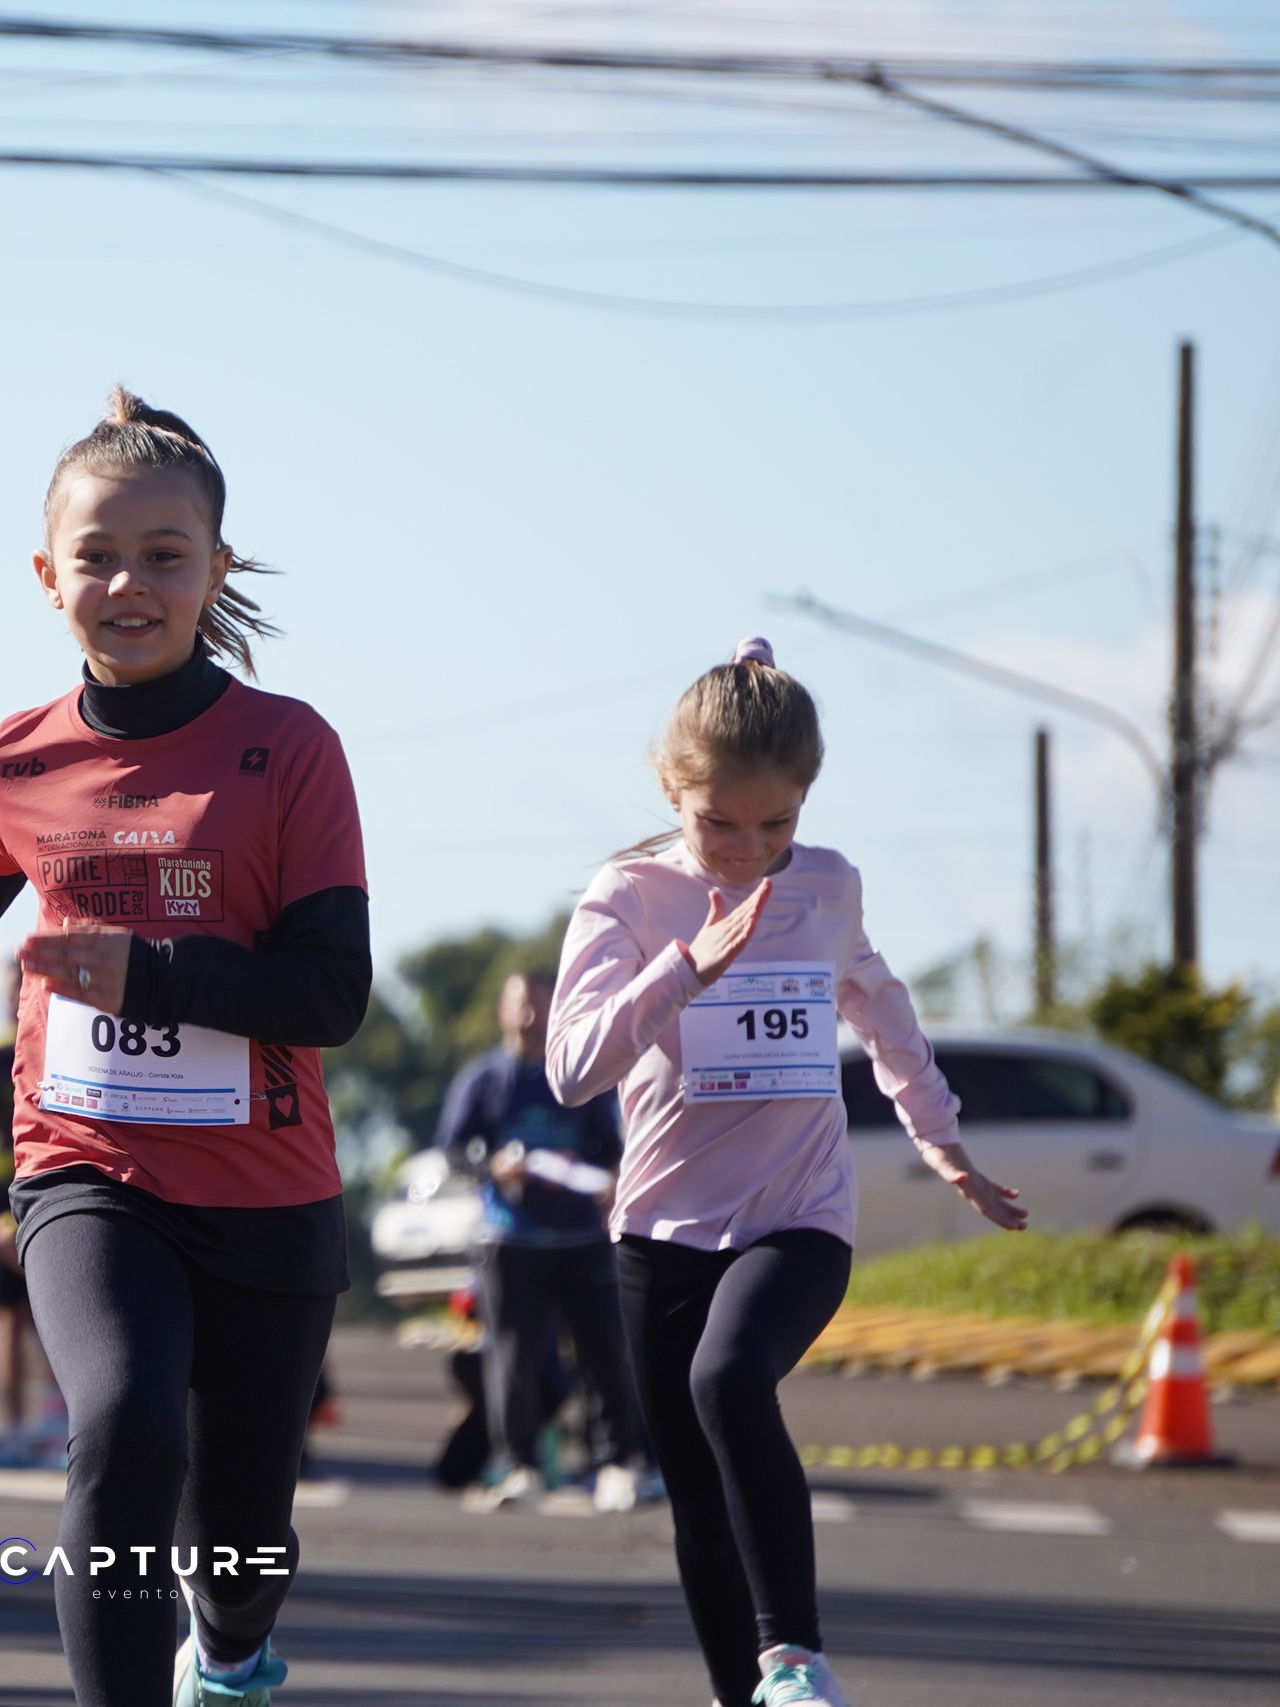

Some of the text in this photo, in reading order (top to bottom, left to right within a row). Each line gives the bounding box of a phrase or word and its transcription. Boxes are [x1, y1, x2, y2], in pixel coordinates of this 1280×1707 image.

[1, 757, 46, 777] rvb
[108, 795, 159, 809] FIBRA
[36, 830, 107, 845] MARATONA
[113, 830, 175, 844] CAIXA
[38, 842, 94, 852] INTERNACIONAL
[158, 857, 211, 870] Maratoninha
[160, 868, 211, 898] KIDS
[132, 890, 143, 902] 20
[76, 891, 131, 917] RODE
[132, 903, 143, 915] 25
[167, 901, 199, 915] KYLY
[737, 1008, 809, 1041] 195
[92, 1014, 181, 1057] 083
[88, 1065, 109, 1074] SERENA
[110, 1068, 118, 1076] DE
[118, 1069, 144, 1077] ARAUJO
[149, 1071, 170, 1079] Corrida
